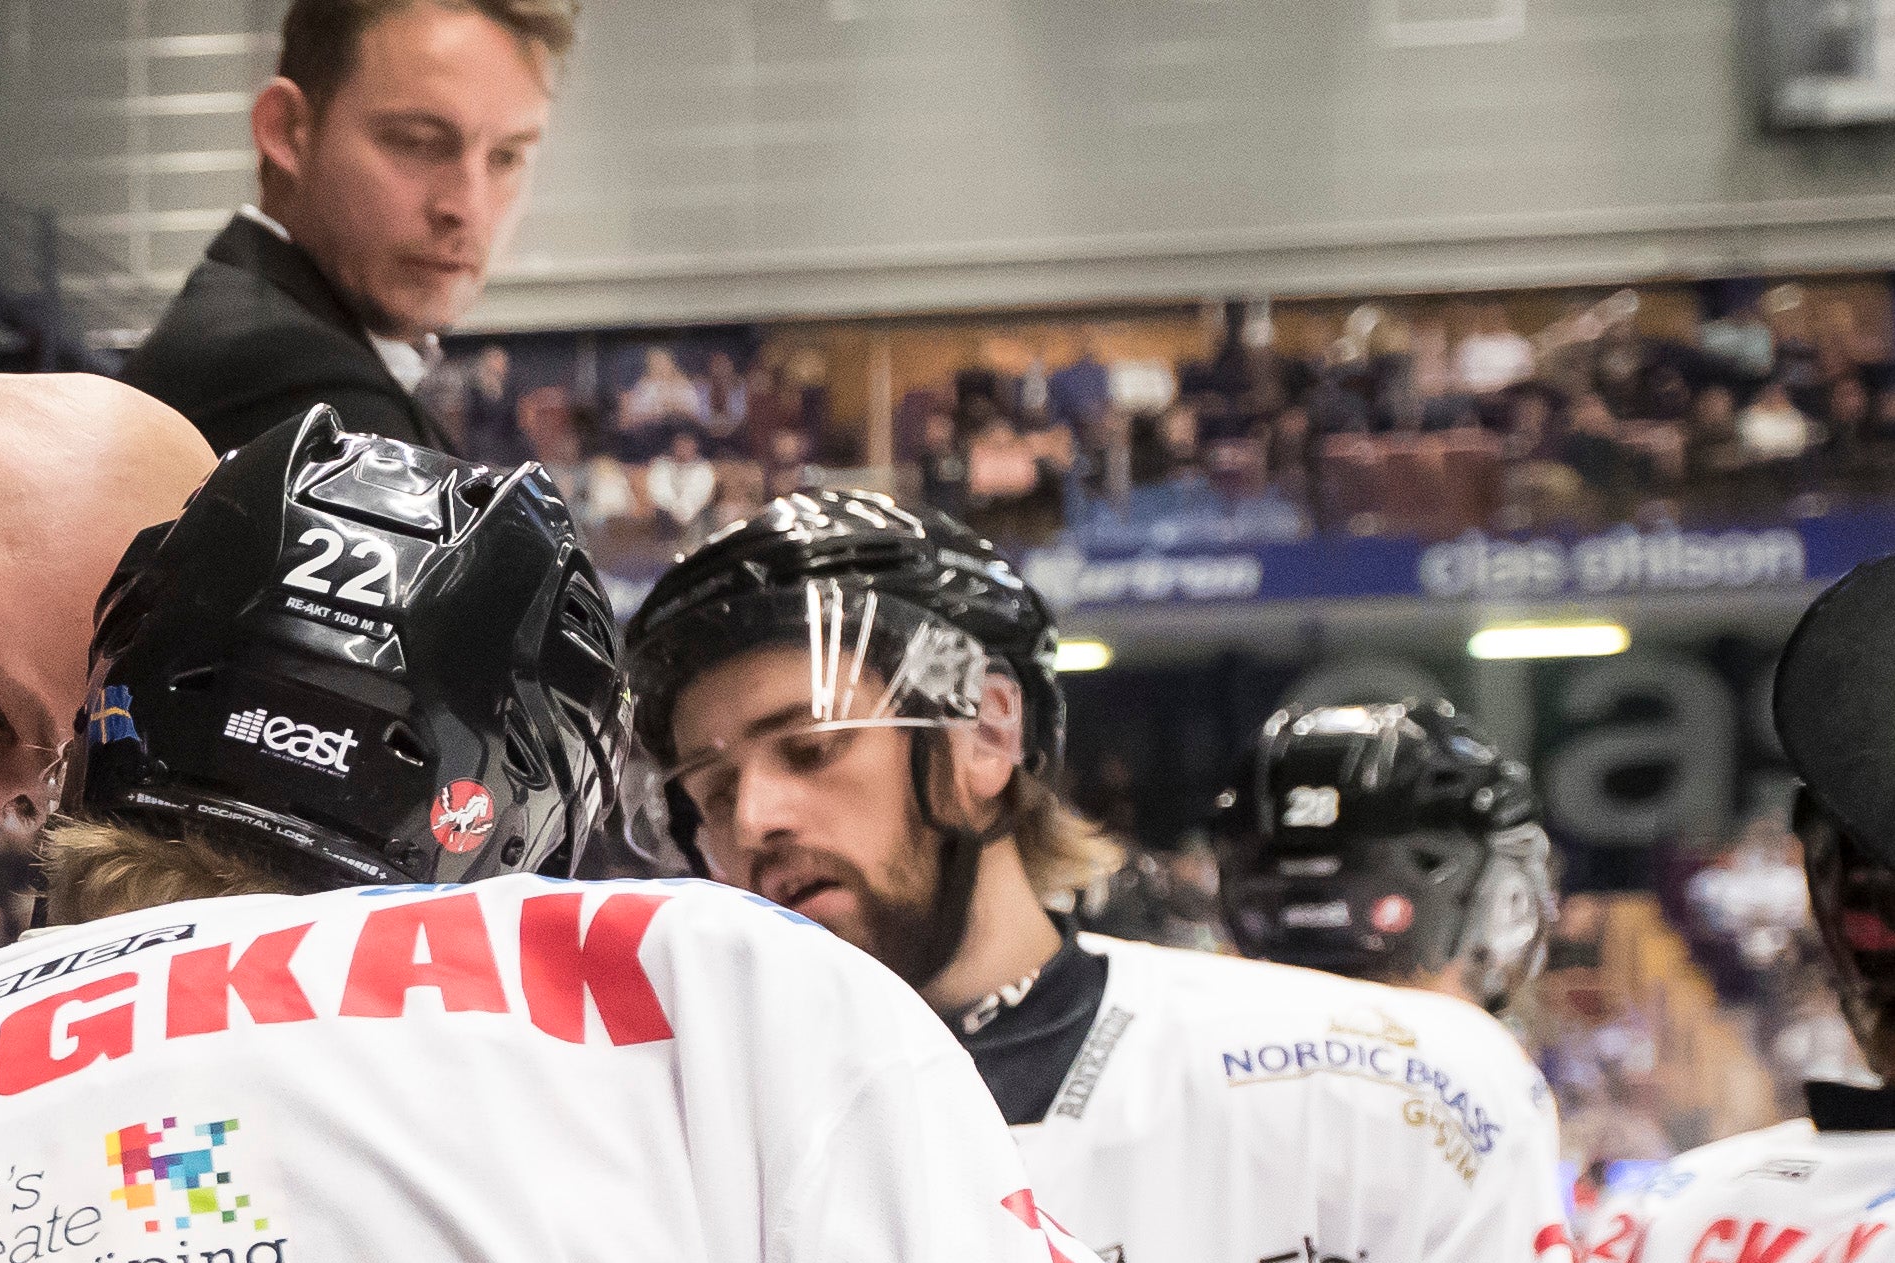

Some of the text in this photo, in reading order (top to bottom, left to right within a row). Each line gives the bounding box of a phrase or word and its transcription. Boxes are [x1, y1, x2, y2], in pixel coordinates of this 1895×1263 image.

[282, 527, 397, 607] 22
[286, 597, 331, 618] RE-AKT
[334, 611, 358, 627] 100
[263, 716, 359, 773] east
[198, 804, 316, 847] OCCIPITAL LOCK
[1222, 1040, 1392, 1079] NORDIC
